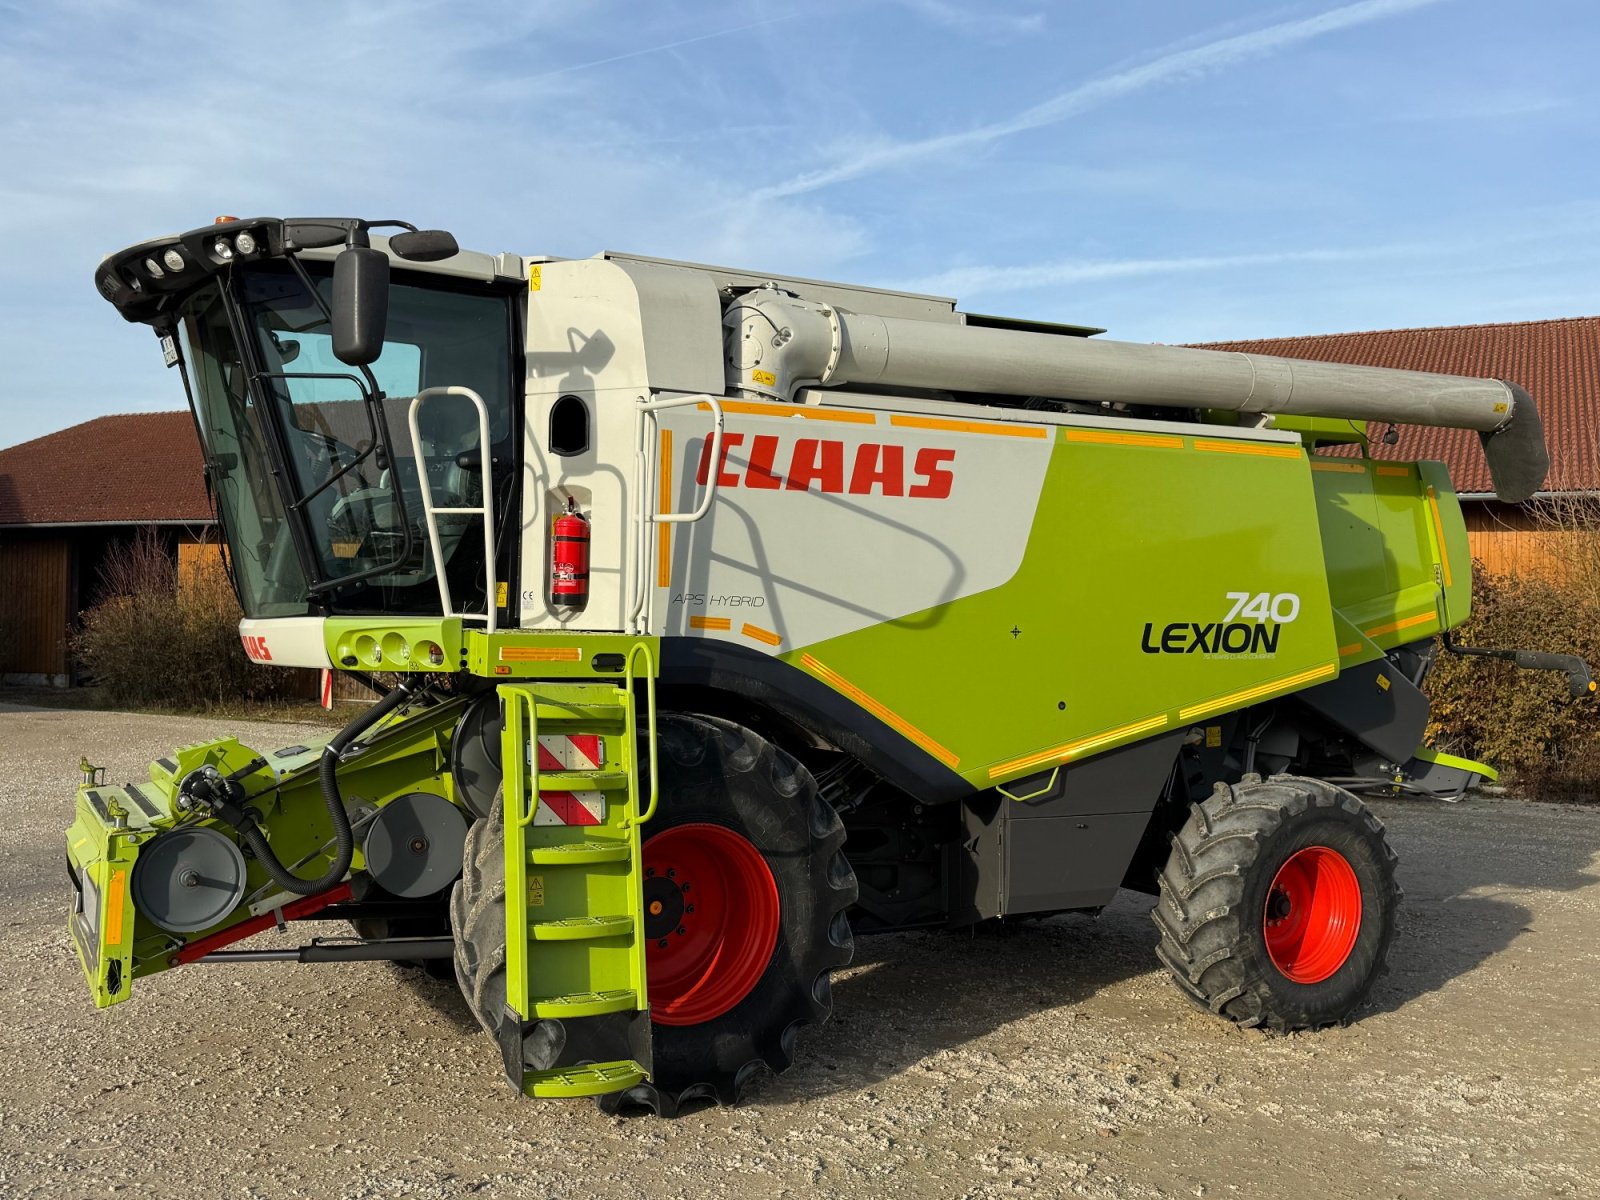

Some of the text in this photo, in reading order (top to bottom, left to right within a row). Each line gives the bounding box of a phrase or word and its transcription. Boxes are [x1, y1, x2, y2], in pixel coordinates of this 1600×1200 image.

[696, 431, 956, 499] CLAAS
[672, 593, 765, 608] APS HYBRID
[1223, 591, 1300, 624] 740
[1141, 622, 1281, 654] LEXION
